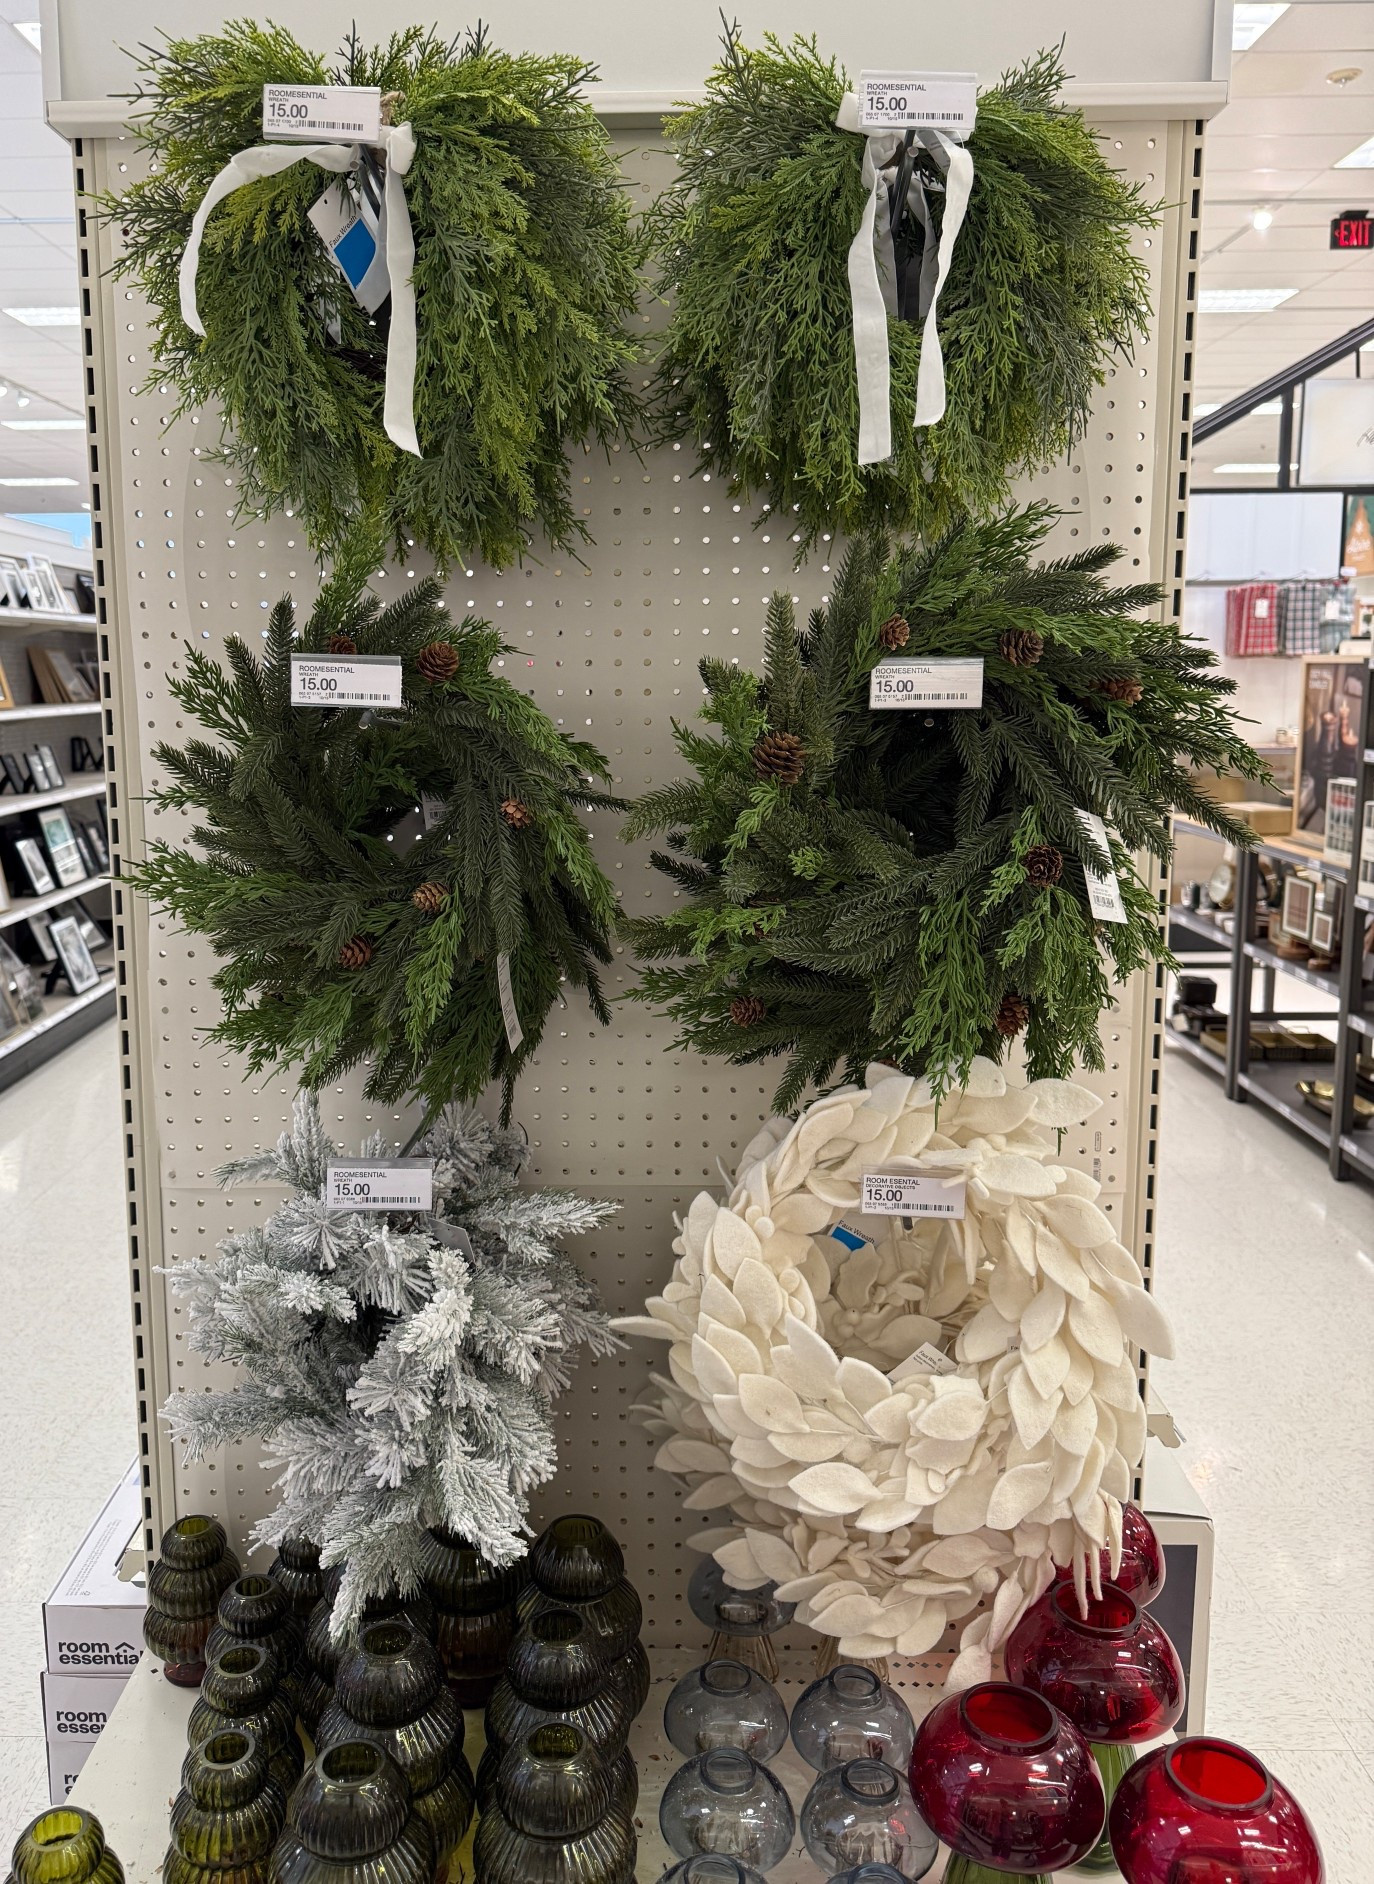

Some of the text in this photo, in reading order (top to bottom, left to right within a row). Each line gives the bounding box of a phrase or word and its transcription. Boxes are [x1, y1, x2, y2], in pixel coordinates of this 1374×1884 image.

[268, 90, 327, 100] ROOMESENTIAL
[868, 97, 907, 111] 15.00
[270, 103, 308, 119] 15.00
[329, 215, 357, 248] Faux Wreath
[1340, 220, 1372, 246] EXIT
[299, 665, 355, 674] ROOMESENTIAL
[300, 678, 337, 691] 15.00
[876, 680, 914, 693] 15.00
[335, 1184, 370, 1195] 15.00
[867, 1189, 903, 1202] 15.00
[839, 1220, 875, 1244] Faux Wreath
[58, 1642, 109, 1653] room
[59, 1650, 143, 1665] essentia
[56, 1711, 107, 1722] room
